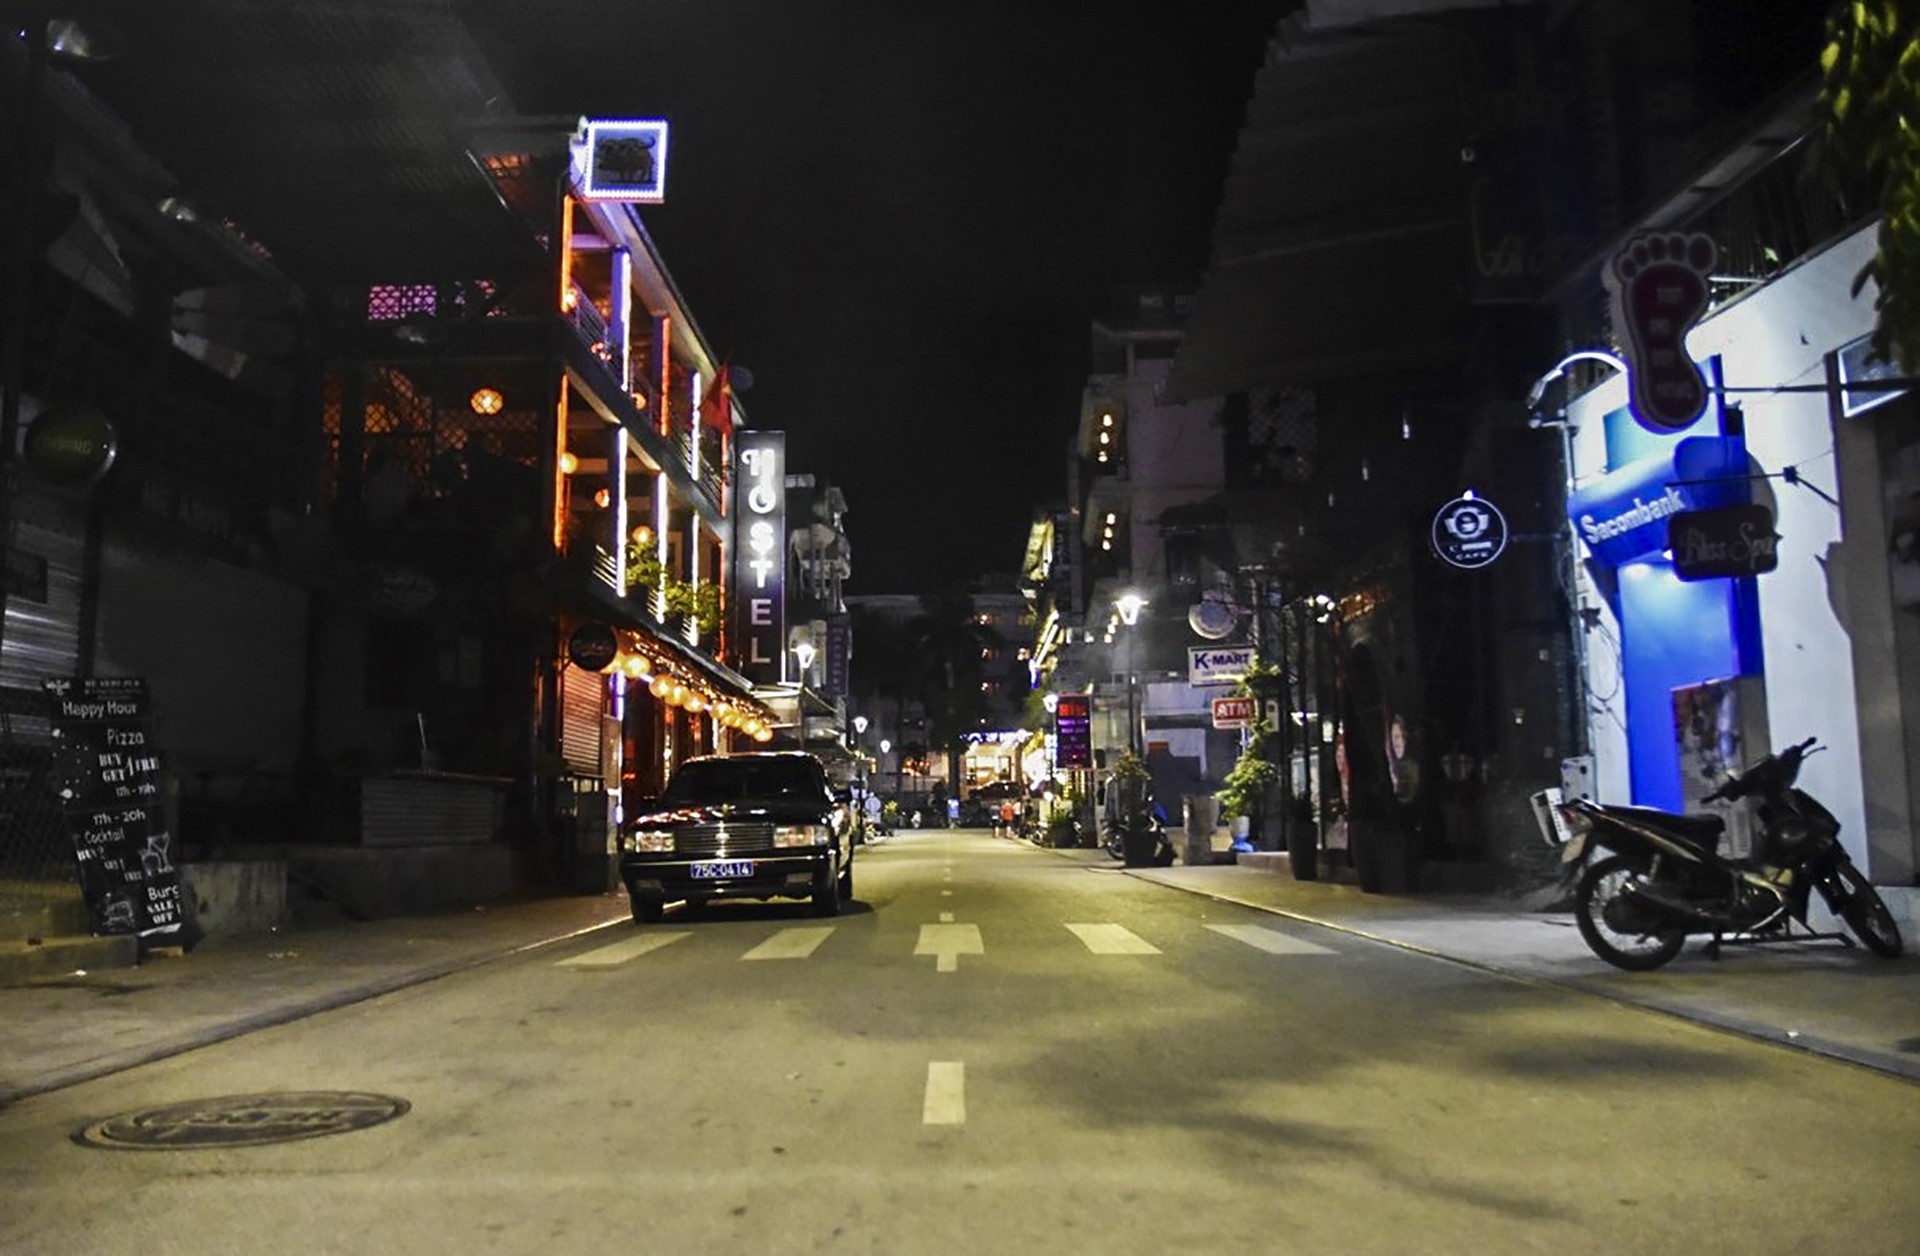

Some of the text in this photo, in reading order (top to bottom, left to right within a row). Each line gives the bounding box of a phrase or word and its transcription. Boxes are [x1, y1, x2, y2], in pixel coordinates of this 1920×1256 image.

[1579, 486, 1685, 544] Sacombank
[1194, 652, 1250, 669] K-MART
[62, 701, 137, 719] Happy Hour
[1216, 702, 1251, 717] ATM
[107, 728, 145, 746] Pizza
